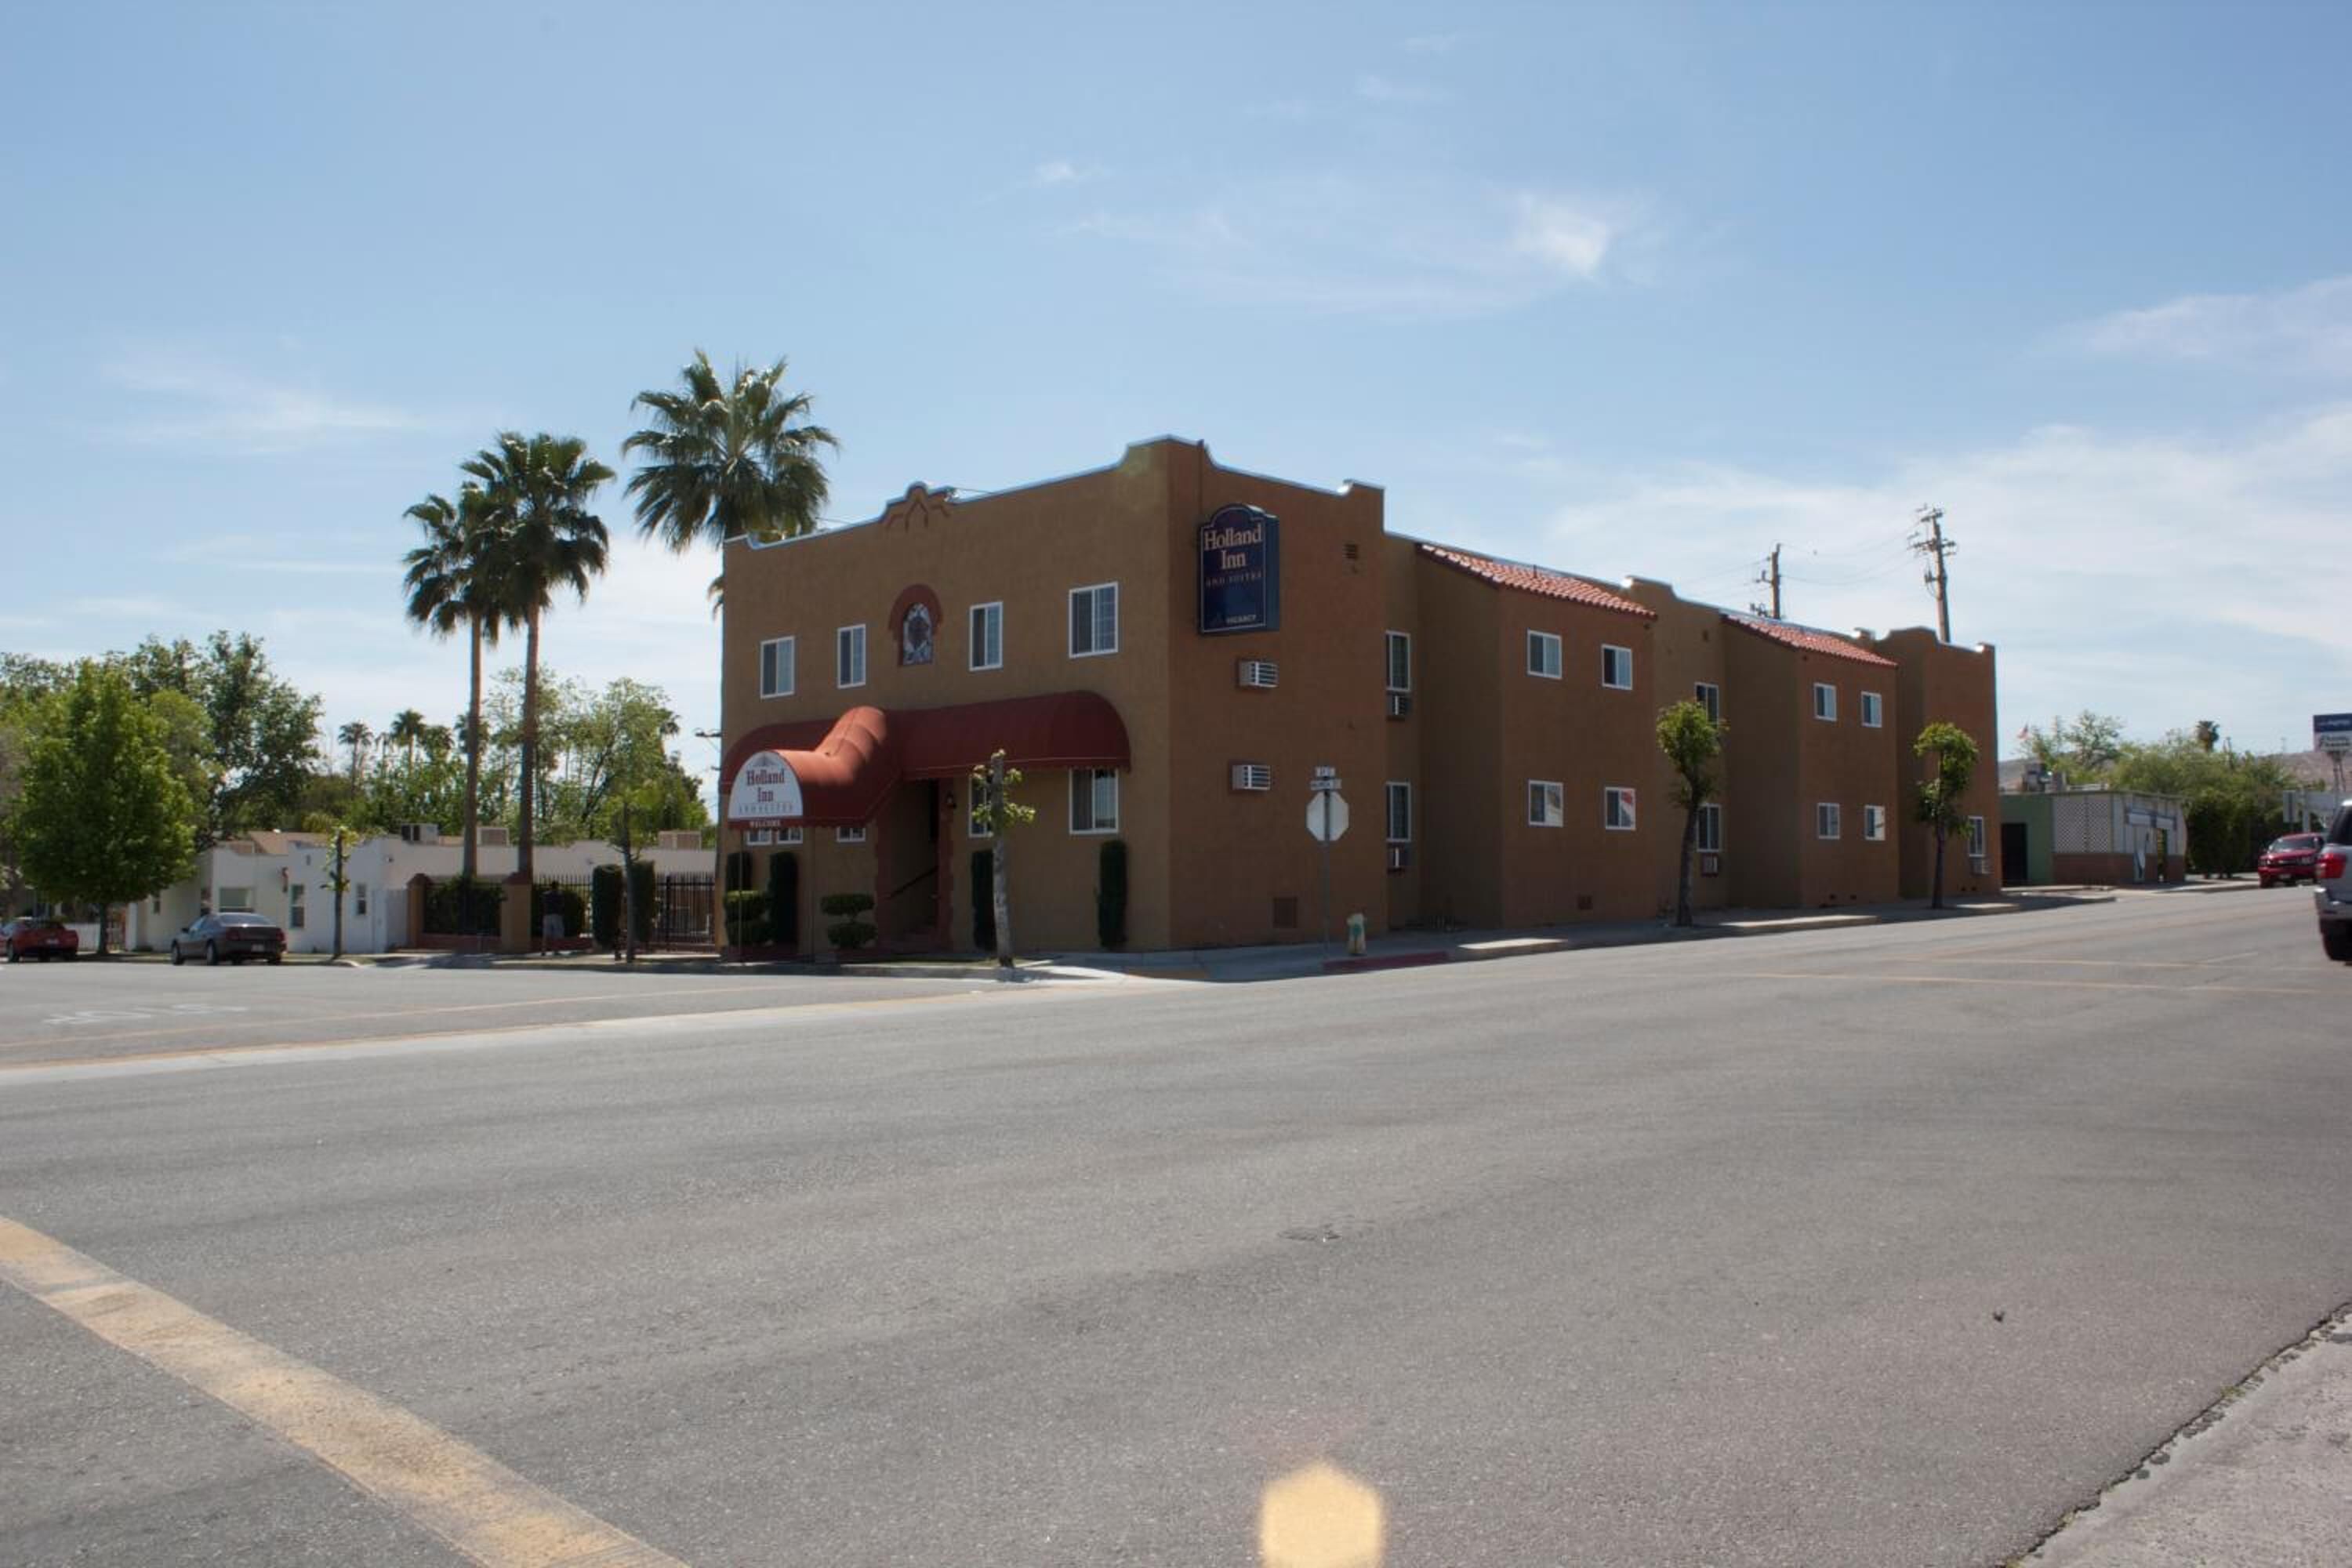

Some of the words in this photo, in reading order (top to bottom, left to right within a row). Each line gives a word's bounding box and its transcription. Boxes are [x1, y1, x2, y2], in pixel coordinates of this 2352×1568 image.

[1203, 523, 1262, 550] Holland
[1221, 550, 1247, 570] Inn
[746, 768, 785, 786] Holland
[757, 786, 774, 803] Inn
